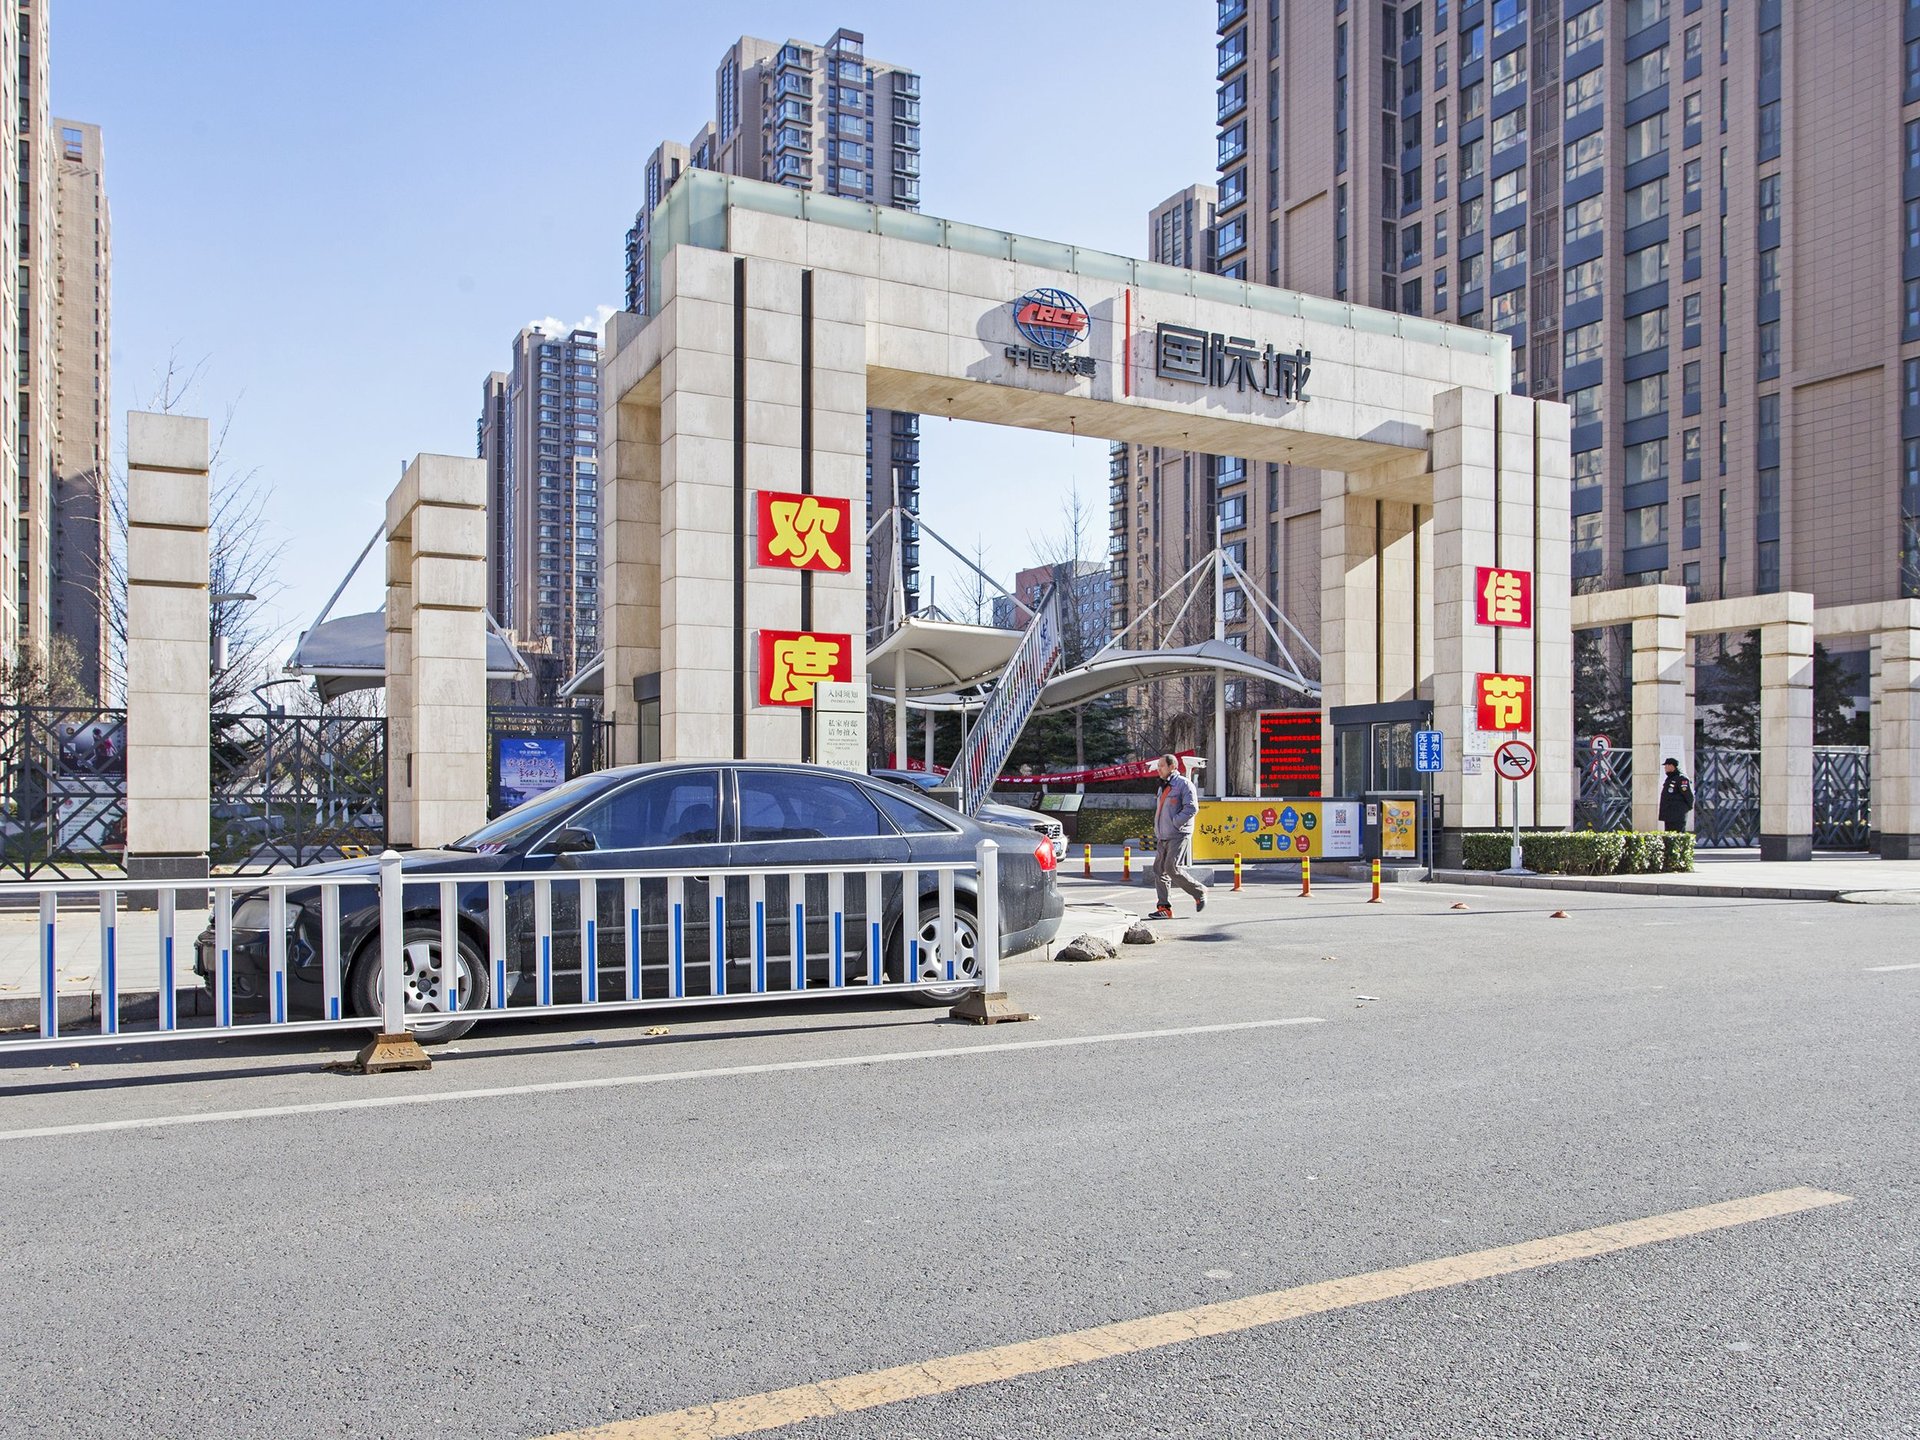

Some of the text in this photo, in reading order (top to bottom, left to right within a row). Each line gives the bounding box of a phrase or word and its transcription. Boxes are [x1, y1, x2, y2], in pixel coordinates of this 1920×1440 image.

[1004, 344, 1097, 378] 中国铁建
[1156, 322, 1312, 402] 国际城
[767, 497, 842, 570] 欢
[1483, 570, 1522, 623] 佳
[769, 635, 840, 703] 度
[1483, 676, 1525, 729] 节
[1419, 733, 1428, 769] 无证车辆
[1431, 733, 1440, 769] 请勿入内
